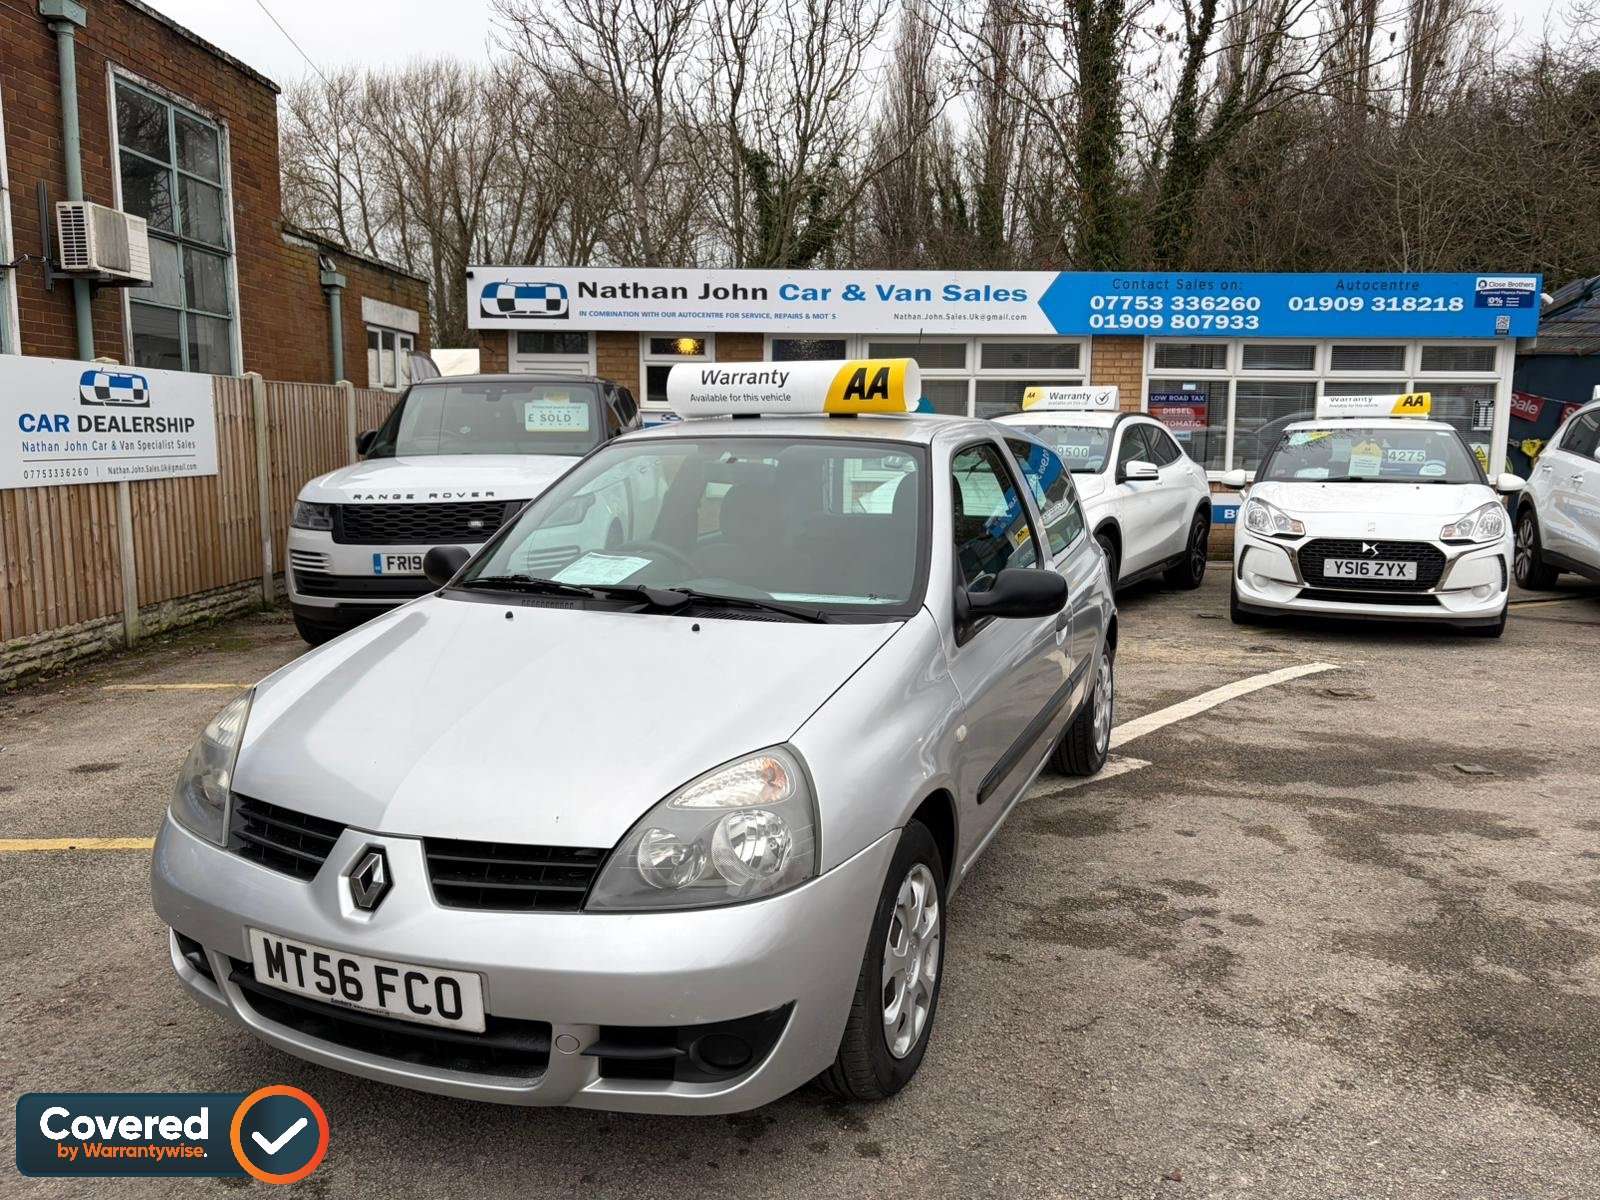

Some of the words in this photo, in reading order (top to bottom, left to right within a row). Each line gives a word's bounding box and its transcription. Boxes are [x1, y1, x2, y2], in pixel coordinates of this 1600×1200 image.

[578, 281, 688, 299] Nathan
[698, 283, 768, 301] John
[779, 284, 832, 301] Car
[841, 284, 866, 301] &
[875, 284, 932, 301] Van
[942, 285, 1028, 302] Sales
[1112, 279, 1169, 290] Contact
[1176, 279, 1214, 291] Sales
[1220, 280, 1243, 291] on:
[1335, 279, 1420, 291] Autocentre
[1089, 295, 1163, 310] 07753
[1170, 296, 1261, 311] 336260
[1288, 296, 1364, 312] 01909
[1371, 296, 1464, 312] 318218
[588, 310, 640, 318] COMBINATION
[678, 311, 724, 319] AUTOCENTRE
[774, 312, 803, 320] REPAIRS
[1089, 314, 1164, 329] 01909
[1170, 314, 1260, 330] 807933
[700, 369, 790, 388] Warranty
[843, 366, 891, 401] AA
[690, 393, 728, 403] Available
[729, 393, 741, 402] for
[742, 392, 759, 402] this
[760, 392, 792, 402] vehicle
[1049, 392, 1092, 401] Warranty
[1402, 395, 1424, 407] AA
[1510, 393, 1539, 414] Sale
[540, 413, 572, 423] SOLD
[1162, 407, 1193, 415] DIESEL
[18, 413, 70, 433] CAR
[77, 415, 195, 433] DEALERSHIP
[22, 440, 60, 453] Nathan
[64, 440, 88, 452] John
[92, 440, 108, 451] Car
[111, 441, 117, 450] &
[119, 440, 135, 451] Van
[137, 439, 175, 451] Specialist
[176, 439, 196, 450] Sales
[1388, 450, 1425, 462] 4275
[23, 467, 89, 480] 07753336260
[428, 491, 495, 499] ROVER
[386, 555, 422, 571] FR19
[1334, 560, 1370, 576] YS16
[1374, 562, 1407, 577] ZYX
[262, 937, 364, 1002] MT56
[374, 964, 463, 1020] FCO
